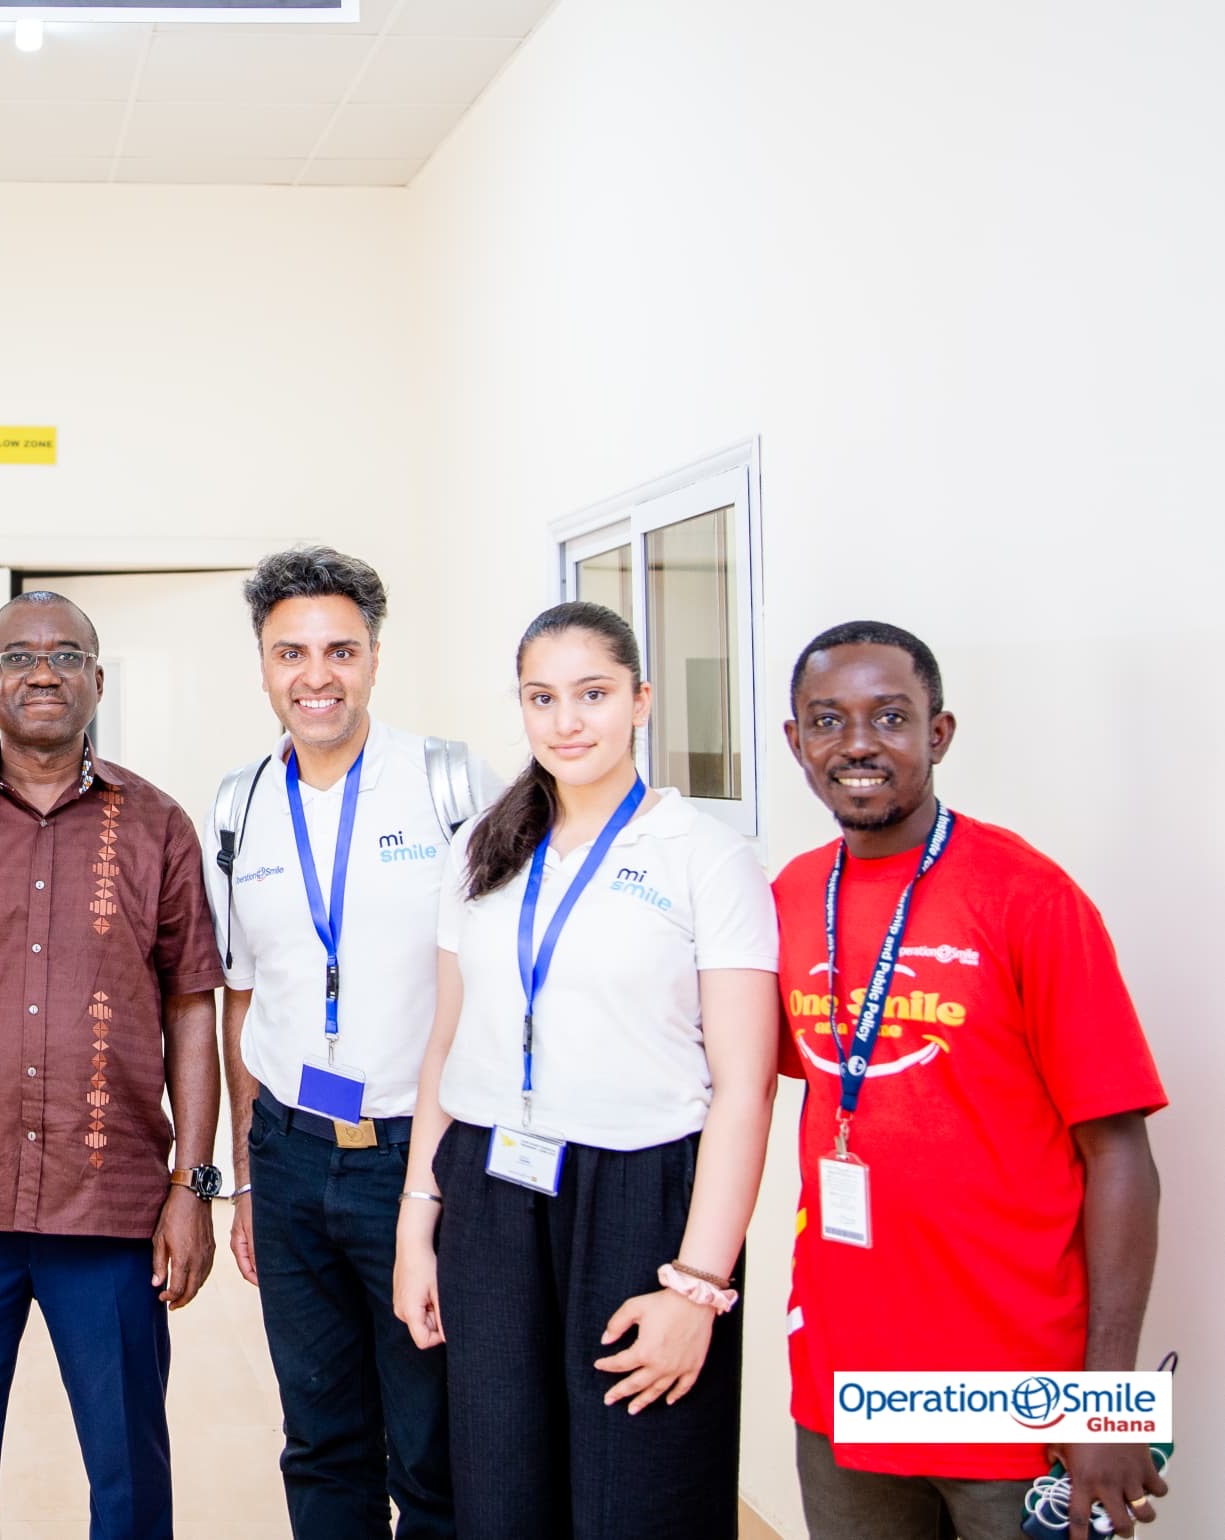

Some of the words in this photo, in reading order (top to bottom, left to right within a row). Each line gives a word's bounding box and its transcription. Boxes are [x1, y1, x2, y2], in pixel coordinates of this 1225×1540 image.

[23, 439, 53, 448] ZONE
[379, 830, 405, 848] mi
[380, 843, 437, 863] smile
[617, 867, 647, 883] mi
[610, 880, 672, 912] smile
[880, 935, 895, 961] and
[868, 961, 892, 1001] Public
[855, 1001, 880, 1042] Policy
